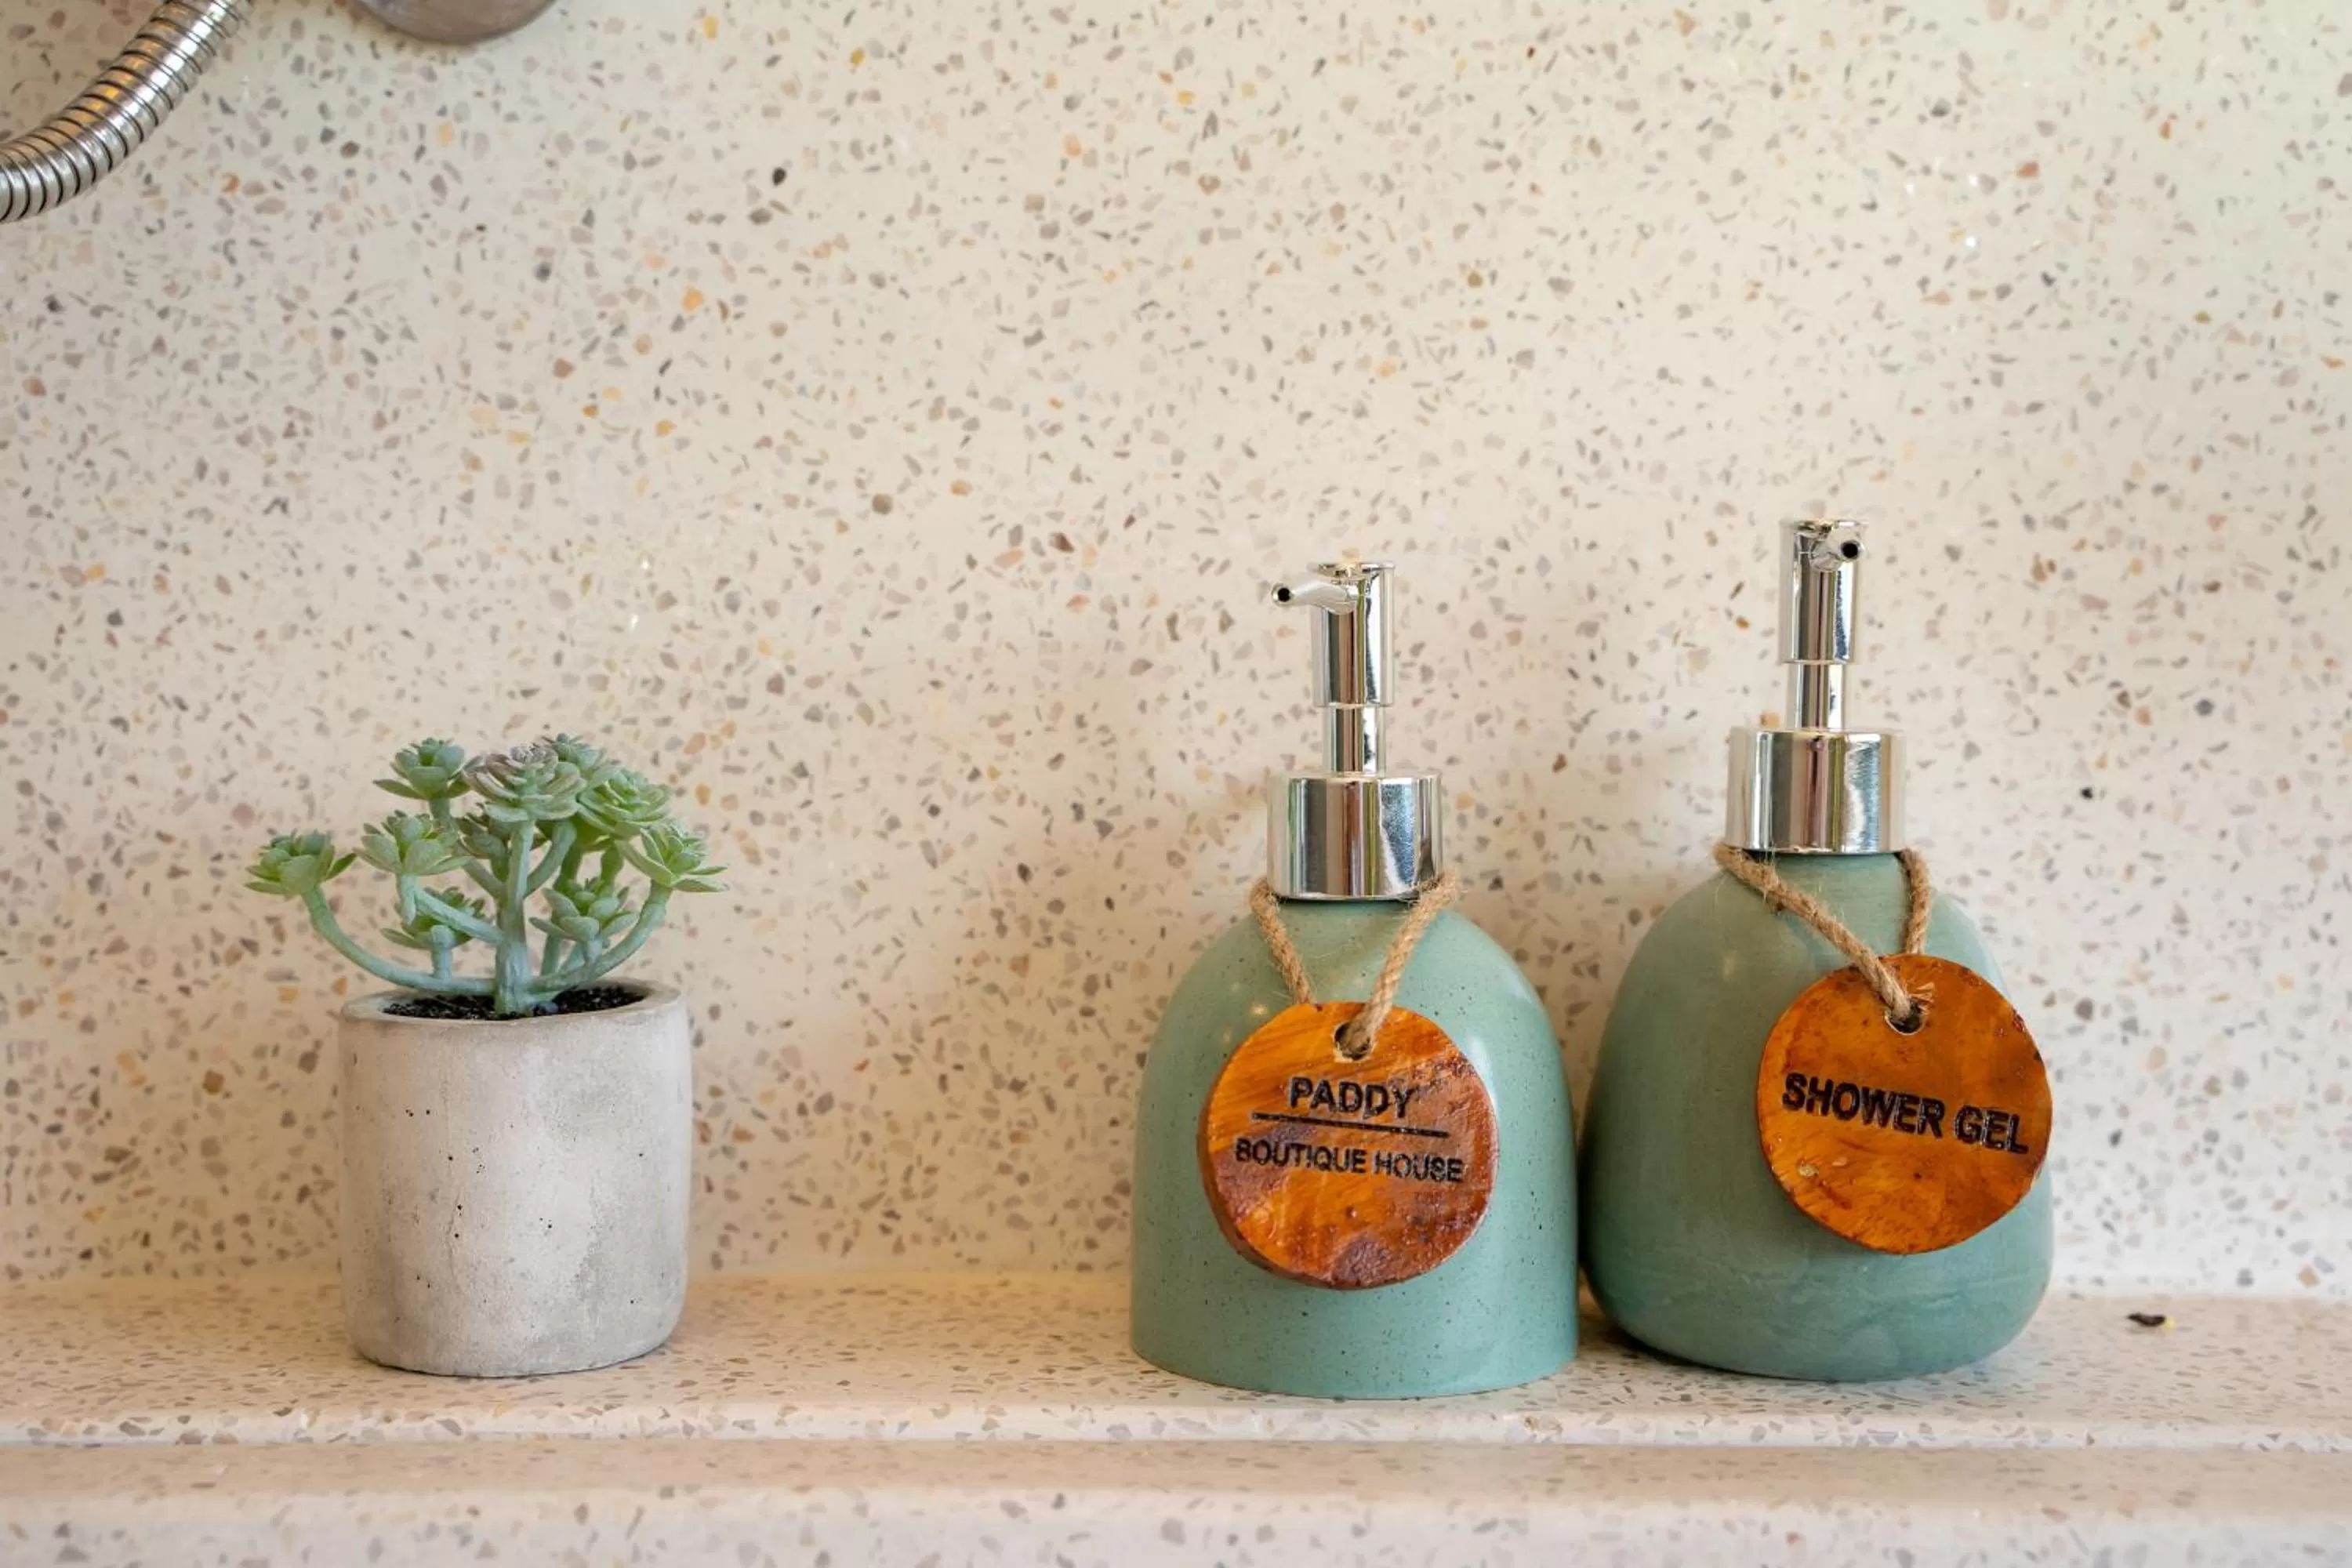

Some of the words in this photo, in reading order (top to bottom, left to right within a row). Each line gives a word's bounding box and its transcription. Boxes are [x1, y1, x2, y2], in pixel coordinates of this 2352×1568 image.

[1290, 1076, 1414, 1119] PADDY
[1782, 1072, 1945, 1138] SHOWER
[1954, 1105, 2029, 1154] GEL
[1235, 1138, 1367, 1174] BOUTIQUE
[1374, 1150, 1465, 1183] HOUSE
